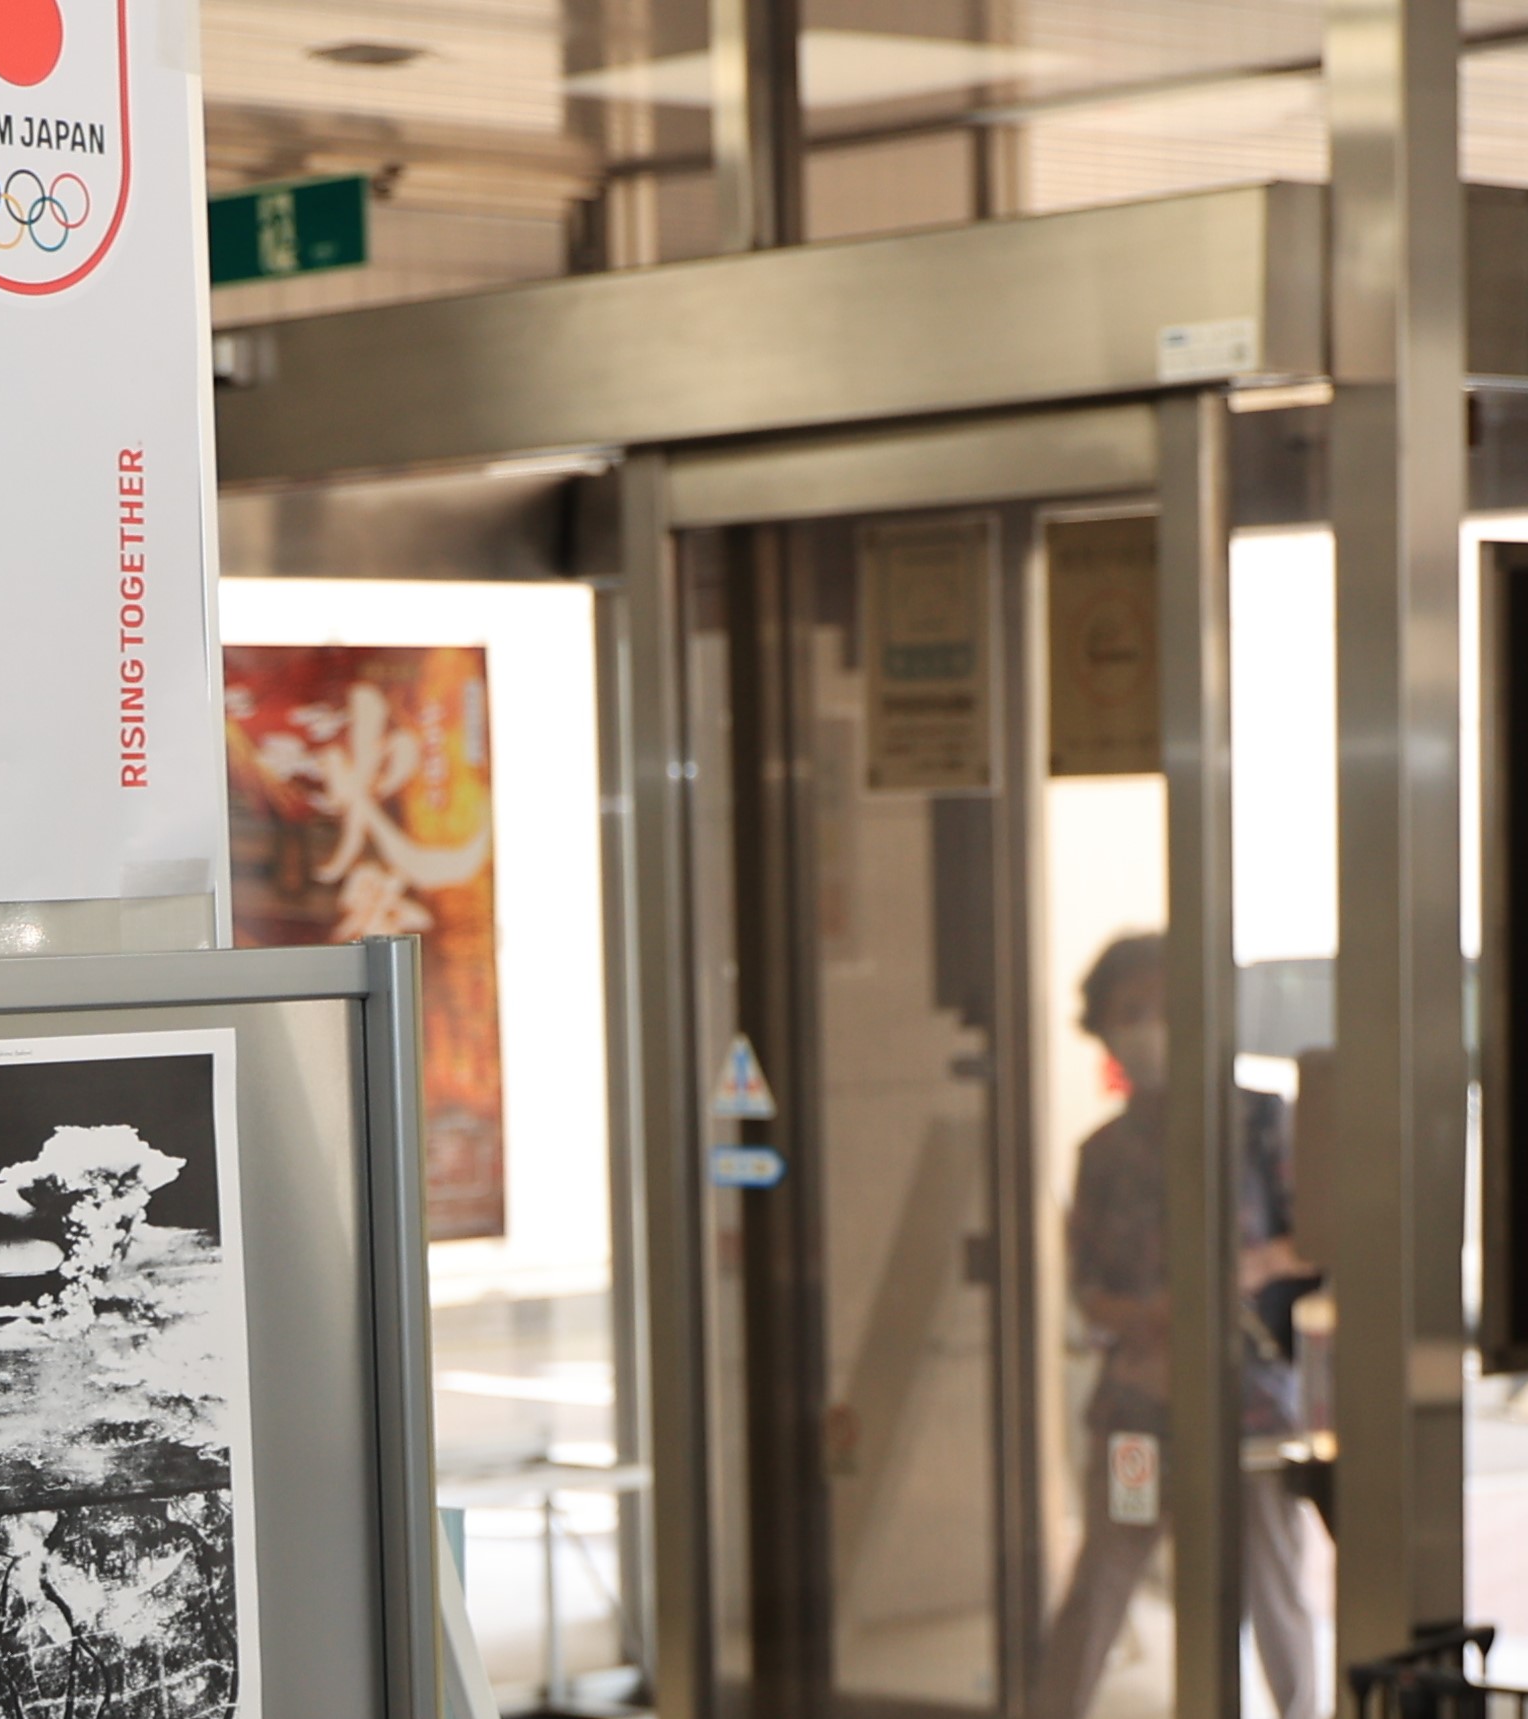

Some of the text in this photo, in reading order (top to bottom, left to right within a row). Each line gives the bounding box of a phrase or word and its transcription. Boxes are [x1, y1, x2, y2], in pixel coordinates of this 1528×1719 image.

[19, 112, 106, 156] JAPAN
[118, 448, 148, 788] RISING TOGETHER
